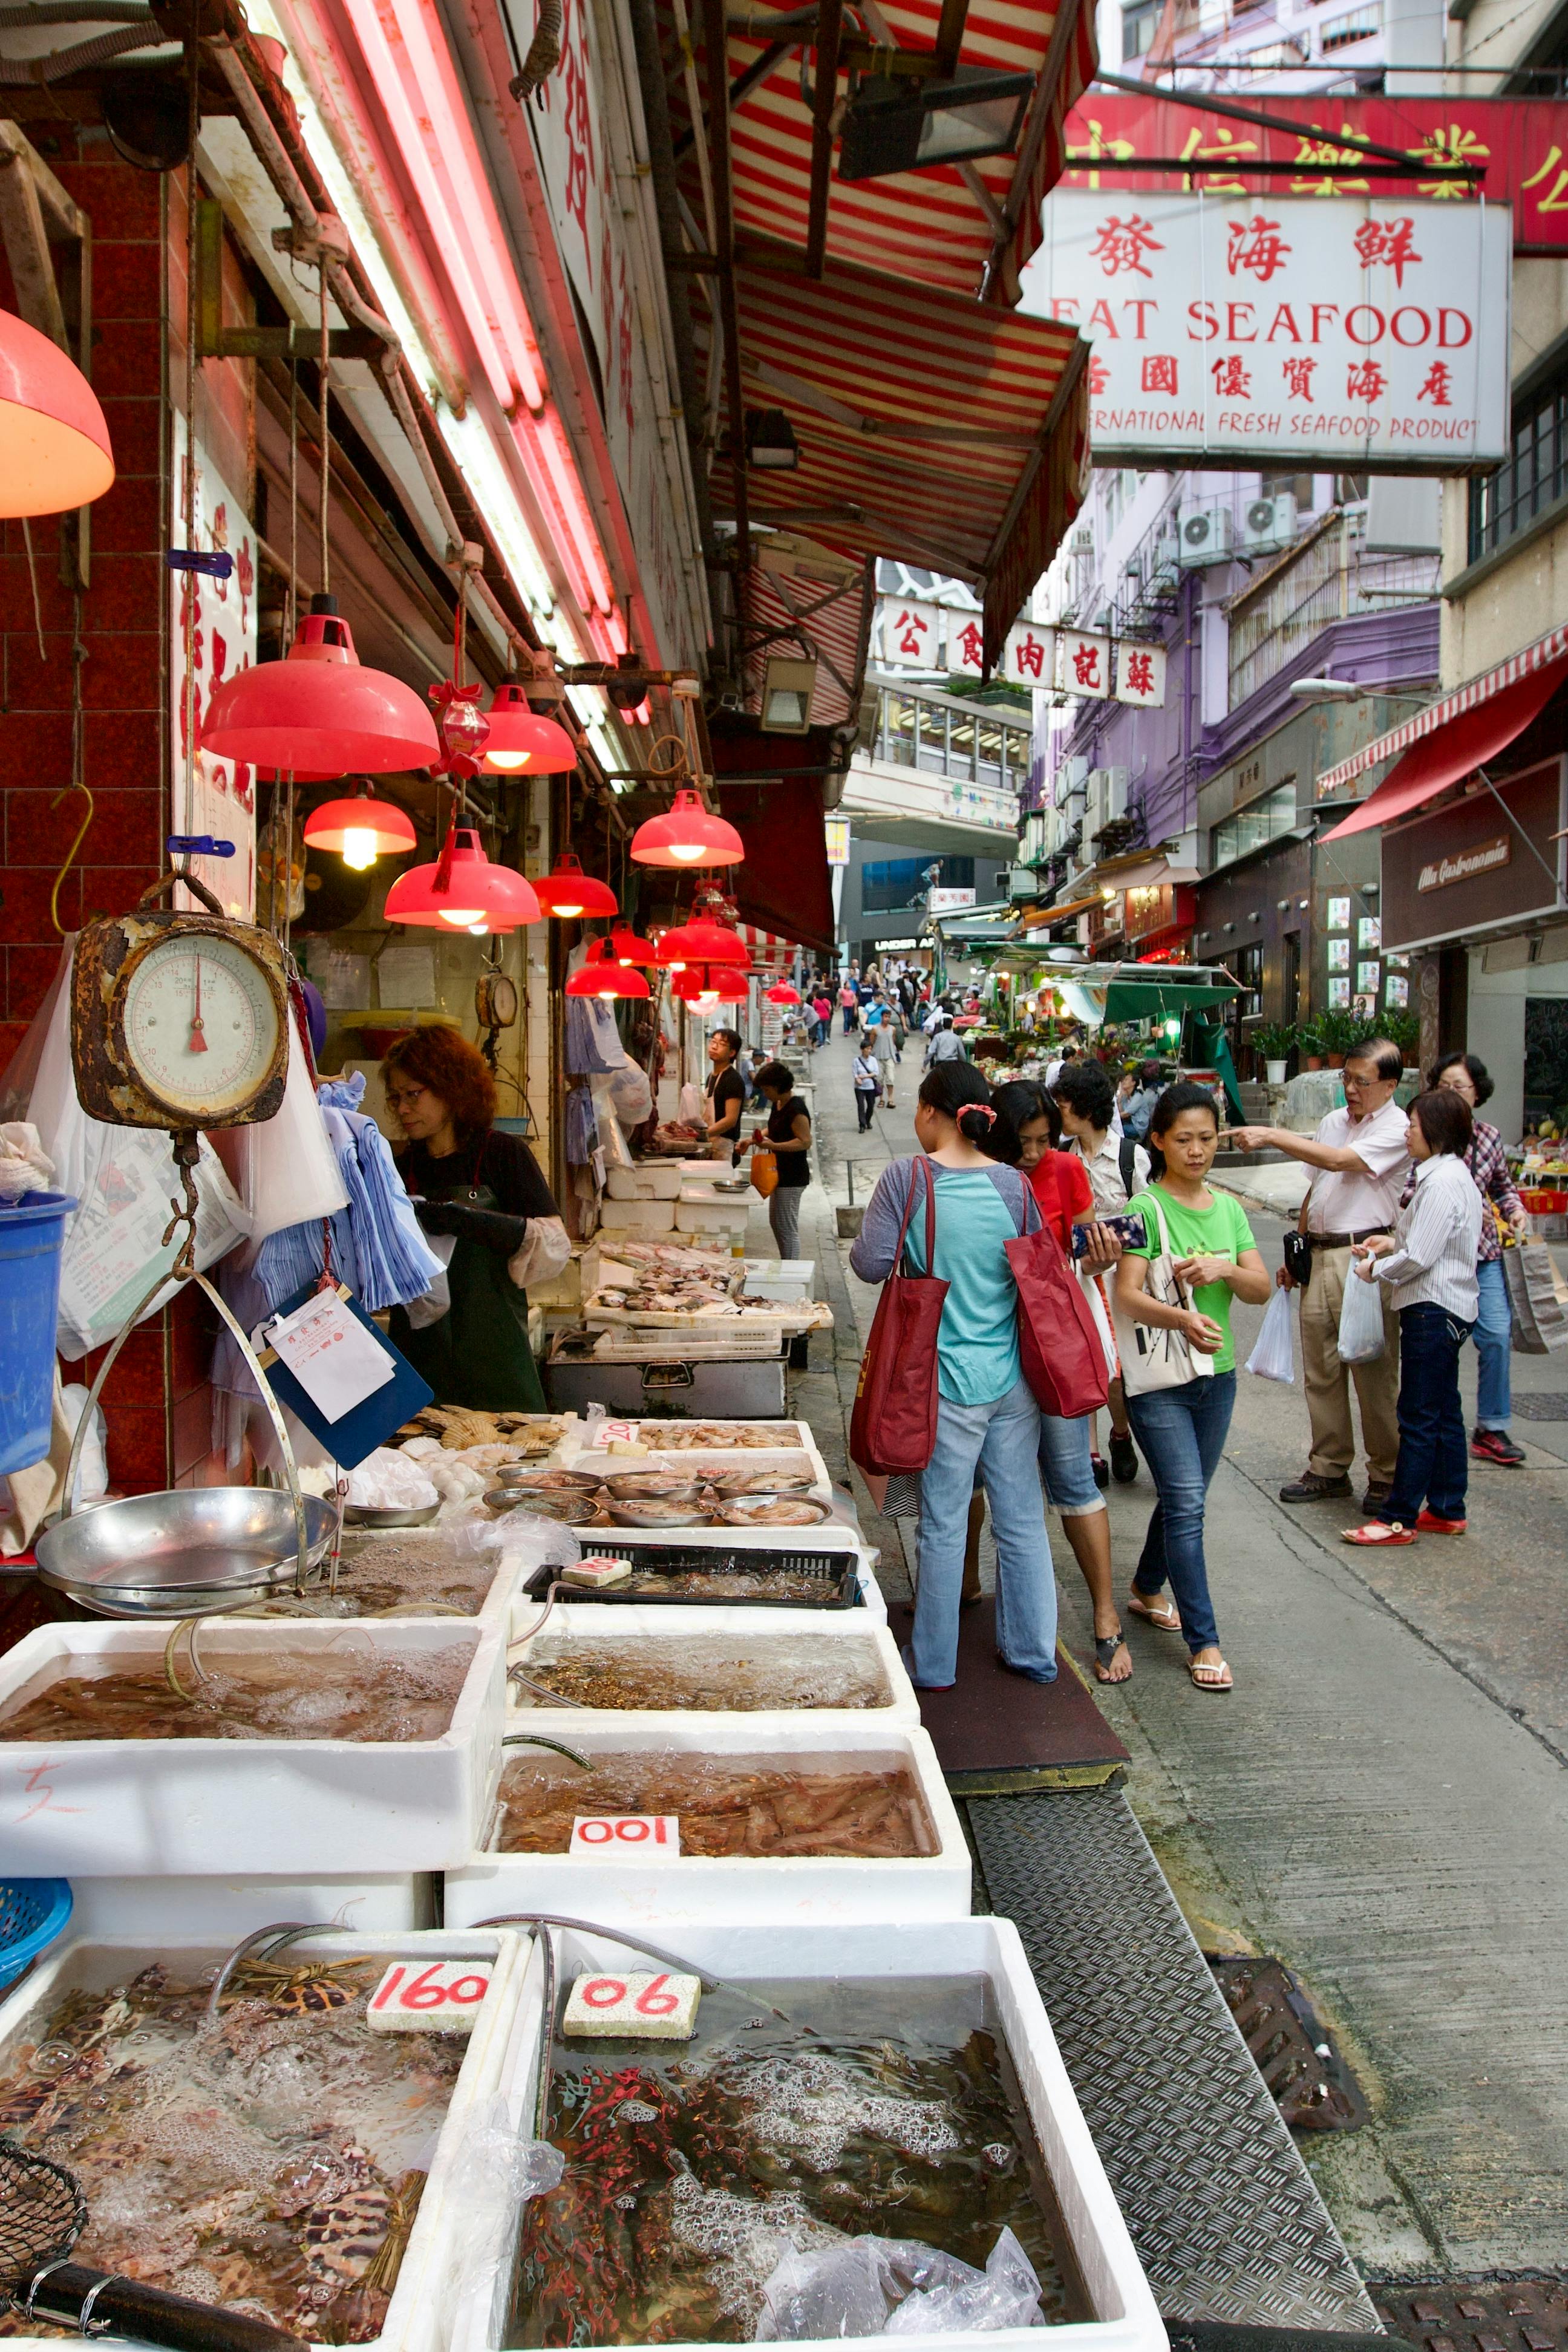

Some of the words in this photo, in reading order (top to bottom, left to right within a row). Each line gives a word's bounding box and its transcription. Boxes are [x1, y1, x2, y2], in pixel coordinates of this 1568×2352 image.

[1024, 212, 1423, 290] 發海鮮
[1187, 301, 1473, 348] SEAFOOD
[1218, 412, 1281, 435] FRESH
[1290, 413, 1381, 437] SEAFOOD
[1390, 417, 1481, 440] PRODUCT
[875, 938, 916, 952] UNDER
[373, 1963, 489, 2010] 160
